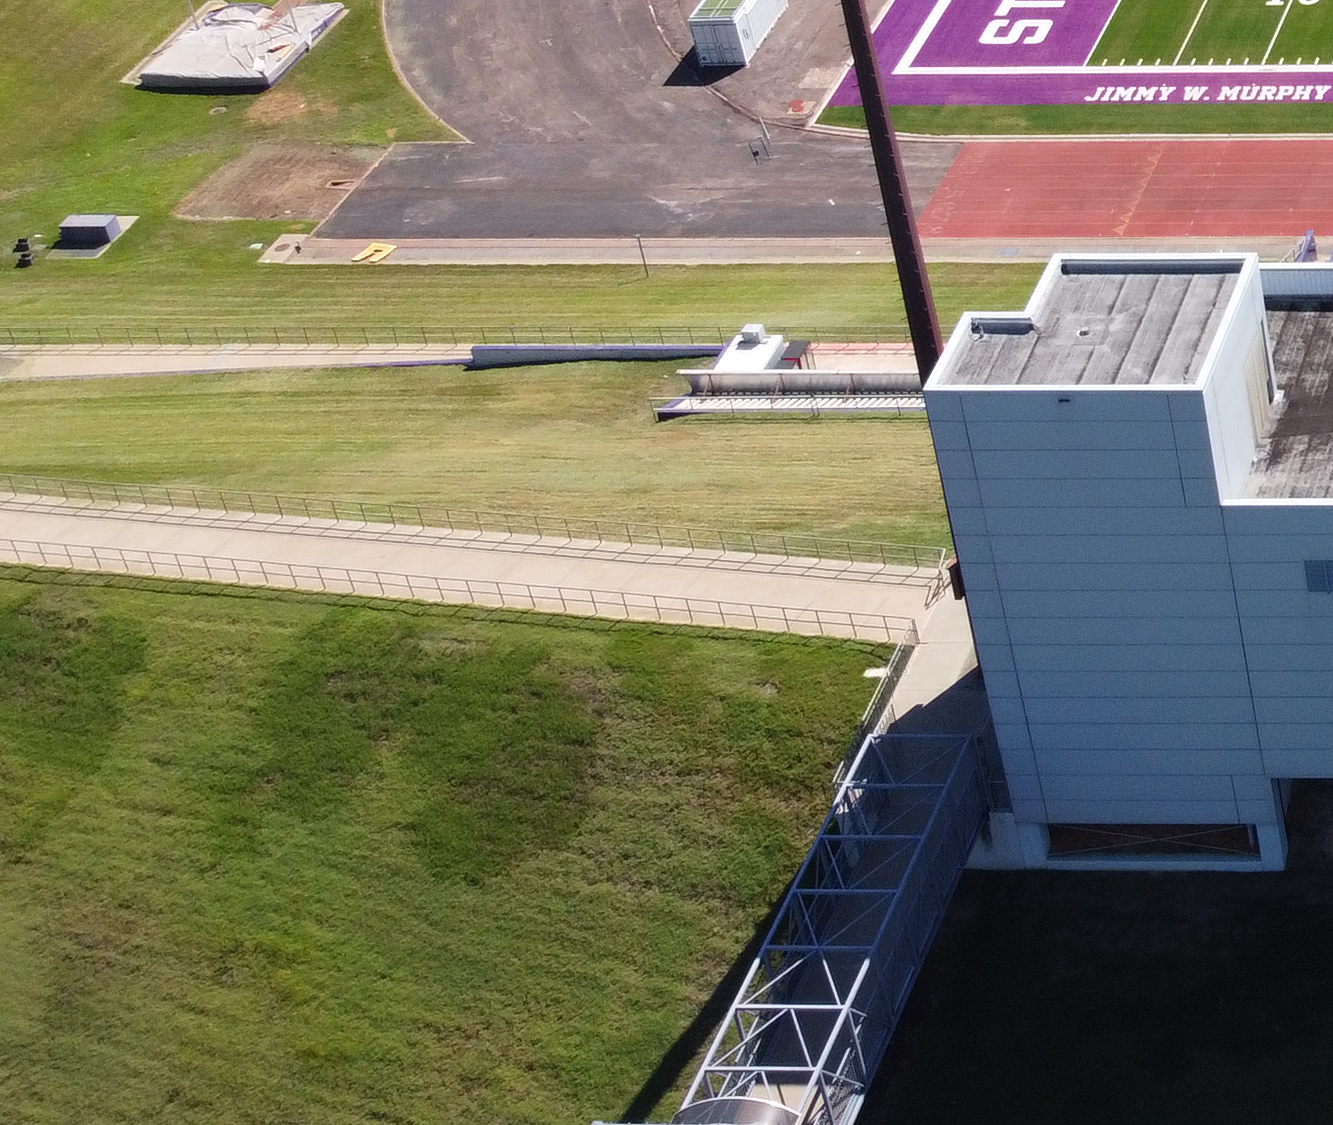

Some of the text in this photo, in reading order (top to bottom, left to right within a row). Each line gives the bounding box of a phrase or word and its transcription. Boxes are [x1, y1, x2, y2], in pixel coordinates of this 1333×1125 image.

[1084, 86, 1170, 102] JIMMY
[1182, 86, 1211, 101] W.
[1217, 83, 1331, 101] MURPHY
